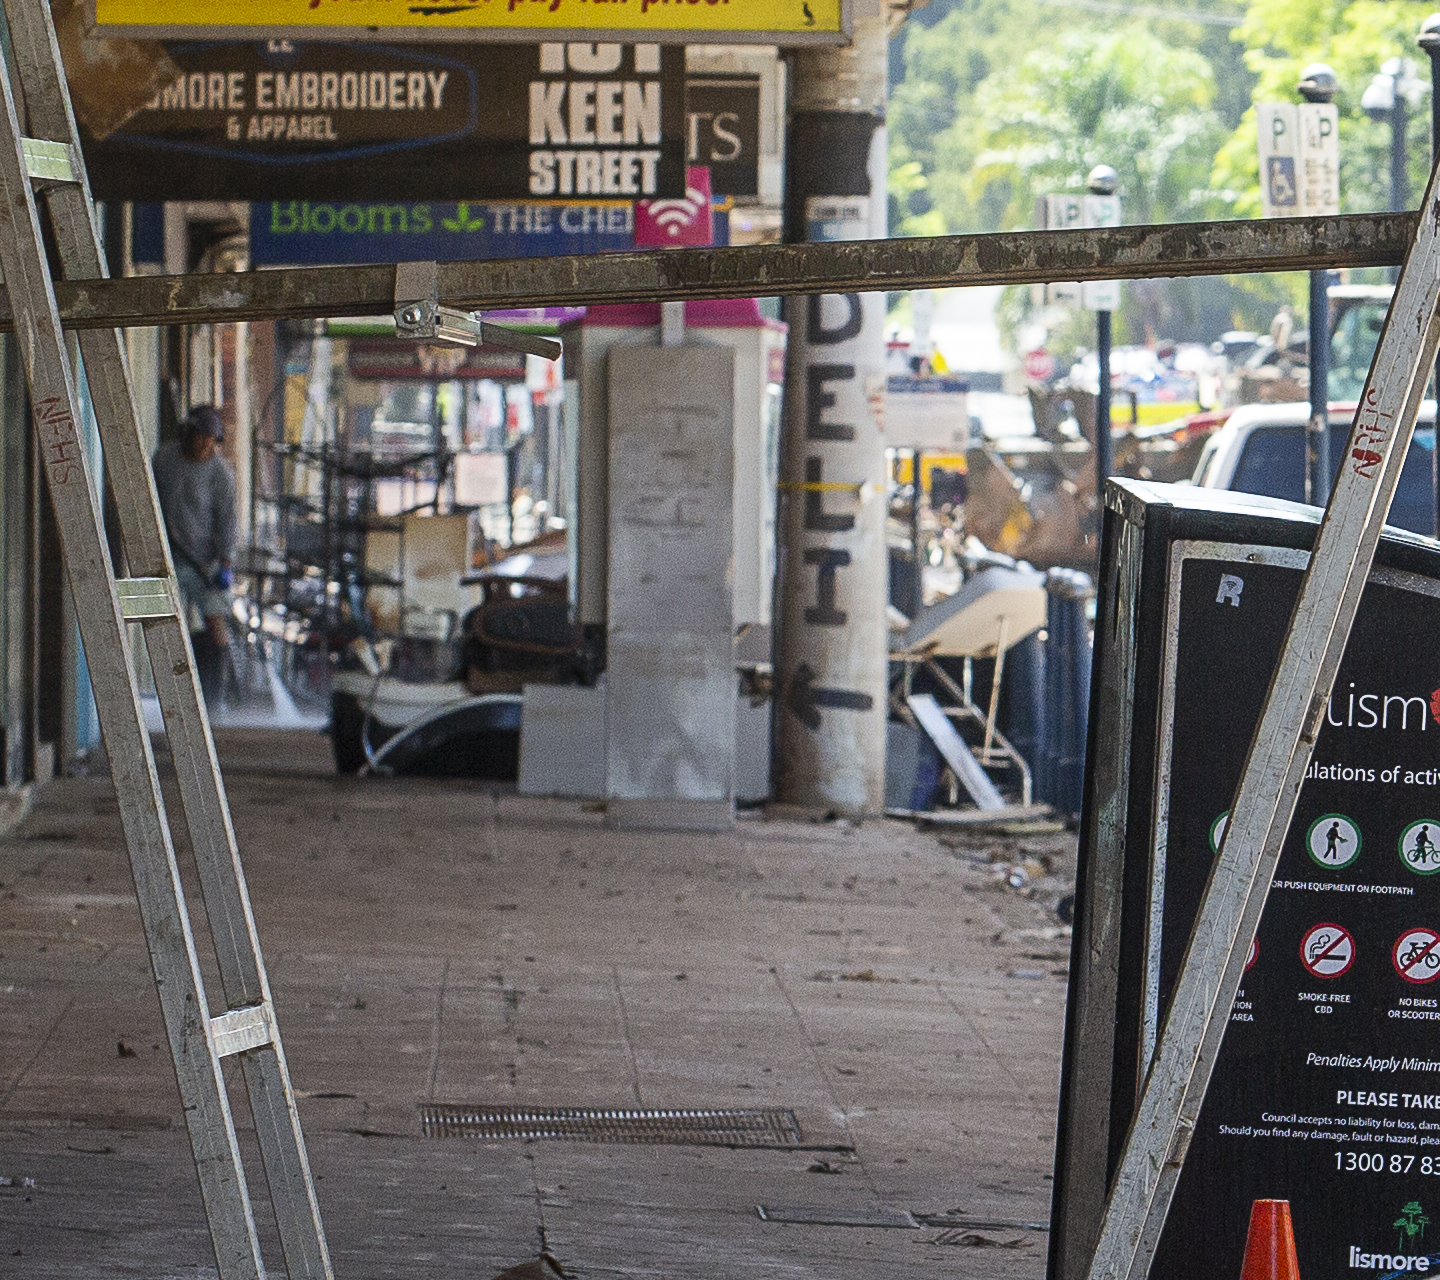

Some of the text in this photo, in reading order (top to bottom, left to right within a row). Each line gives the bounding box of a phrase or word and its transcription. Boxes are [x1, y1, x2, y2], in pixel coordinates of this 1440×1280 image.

[255, 71, 449, 111] EMBROIDERY
[527, 80, 662, 146] KEEN
[246, 115, 339, 141] APPAREL
[685, 111, 743, 162] TS
[527, 149, 662, 196] STREET
[270, 200, 433, 236] Blooms
[488, 206, 553, 234] THE
[803, 293, 863, 626] DELI
[1304, 760, 1376, 783] ulations
[1380, 764, 1401, 784] of
[1284, 880, 1307, 891] PUSH
[1308, 881, 1356, 893] EQUIPMENT
[1357, 884, 1369, 893] ON
[1370, 885, 1414, 896] FOOTPATH
[1297, 992, 1351, 1004] SMOKE-FREE
[1398, 997, 1438, 1009] NO BIKES
[1231, 1013, 1254, 1022] AREA
[1314, 1005, 1334, 1015] CBD
[1387, 1009, 1401, 1019] OR
[1306, 1052, 1363, 1069] Penalties
[1363, 1055, 1402, 1074] Apply
[1336, 1089, 1399, 1108] PLEASE
[1261, 1111, 1298, 1123] Council
[1298, 1114, 1333, 1126] accepts
[1334, 1117, 1347, 1126] no
[1348, 1116, 1382, 1129] liability
[1383, 1117, 1396, 1128] for
[1396, 1118, 1416, 1131] loss,
[1219, 1124, 1252, 1136] Should
[1252, 1127, 1271, 1138] you
[1272, 1126, 1291, 1138] find
[1291, 1130, 1310, 1141] any
[1310, 1129, 1351, 1144] damage,
[1351, 1131, 1374, 1142] fault
[1374, 1134, 1385, 1143] or
[1386, 1133, 1419, 1146] hazard,
[1333, 1150, 1385, 1173] 1300
[1389, 1153, 1416, 1175] 87
[1348, 1244, 1431, 1272] lismore
